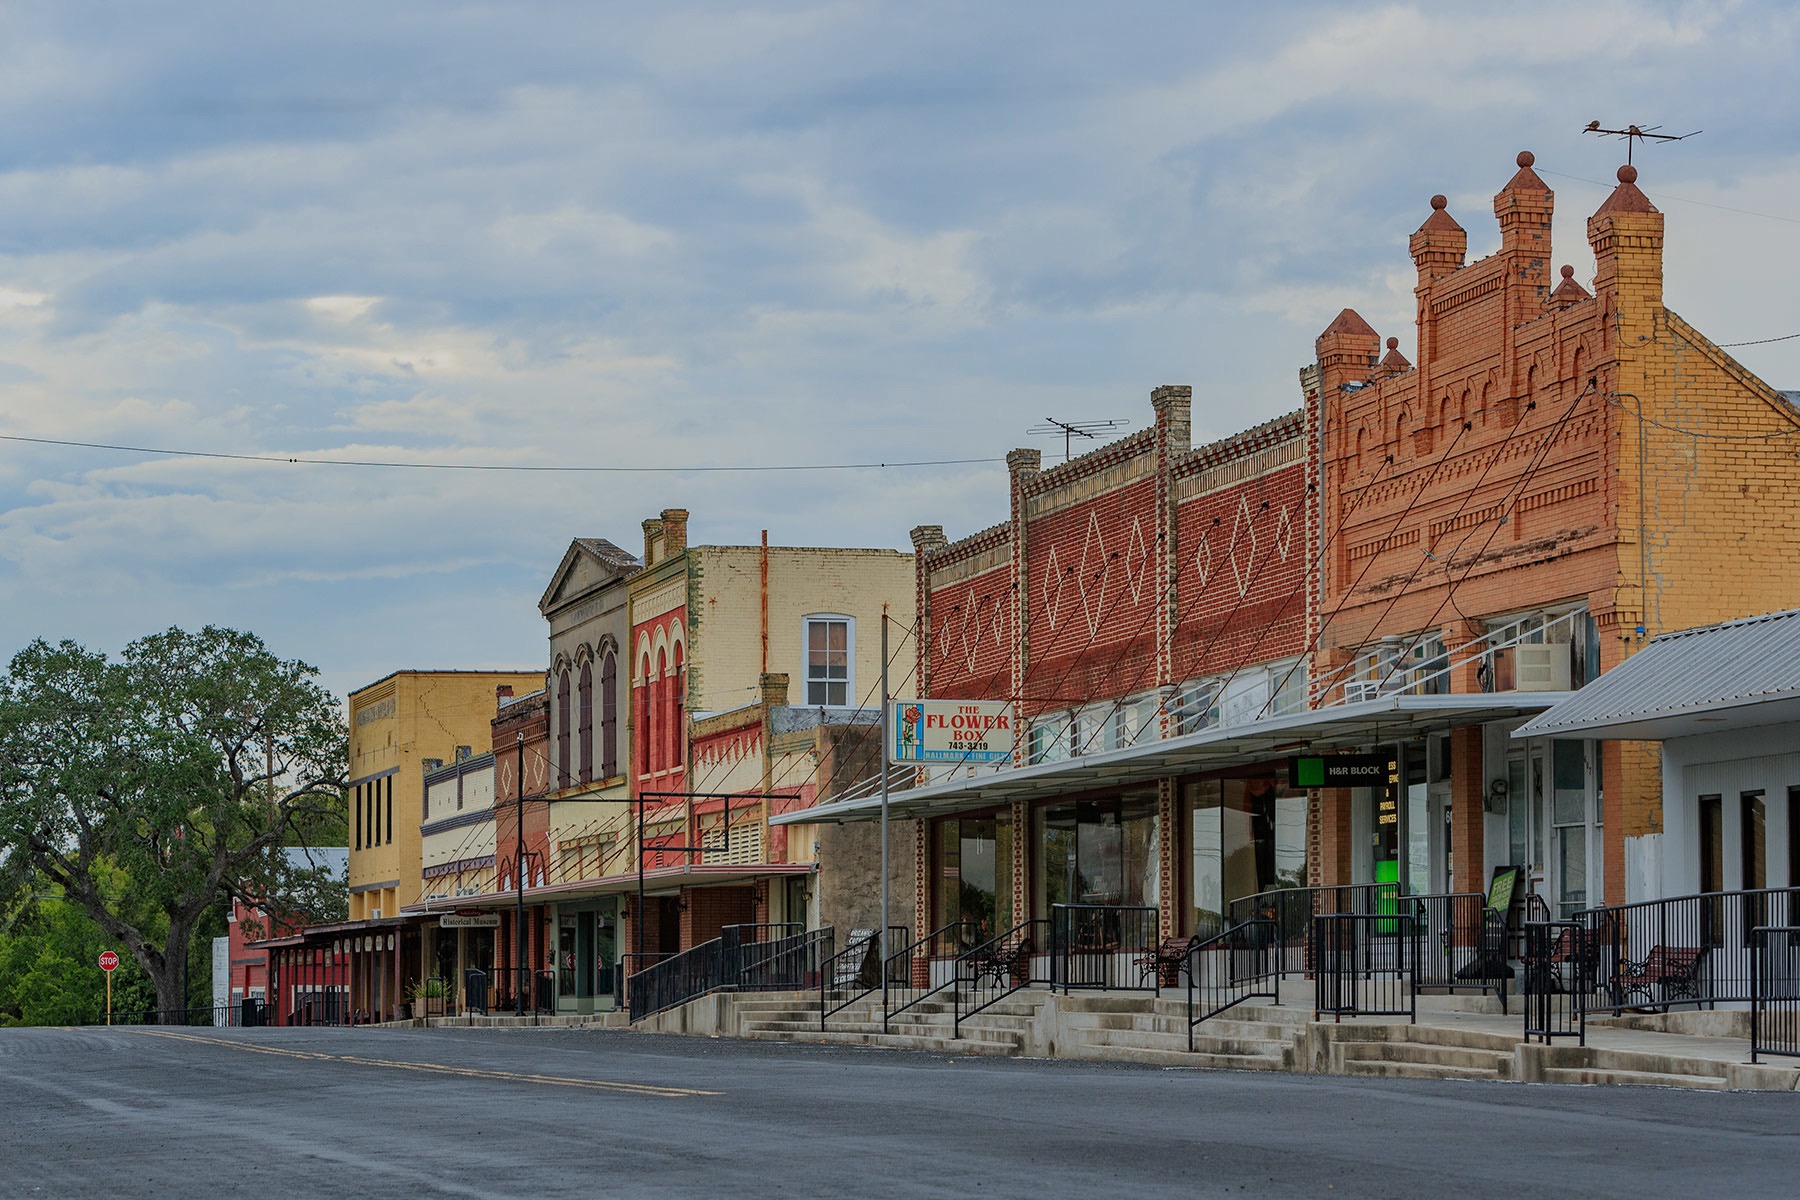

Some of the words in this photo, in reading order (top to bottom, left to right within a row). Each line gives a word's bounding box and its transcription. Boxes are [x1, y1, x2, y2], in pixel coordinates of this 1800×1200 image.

[958, 706, 980, 714] THE
[926, 714, 1010, 729] FLOWER
[953, 730, 984, 741] BOX
[948, 741, 988, 750] 743-3219
[925, 751, 964, 759] HALLMARK
[1329, 767, 1348, 775] H&R
[1351, 767, 1380, 775] BLOCK
[1380, 801, 1396, 811] PAYROLL
[1379, 813, 1397, 825] SERVICES
[1492, 876, 1513, 897] FREE
[442, 918, 472, 926] Historical
[473, 918, 498, 926] Museum
[100, 957, 118, 965] STOP
